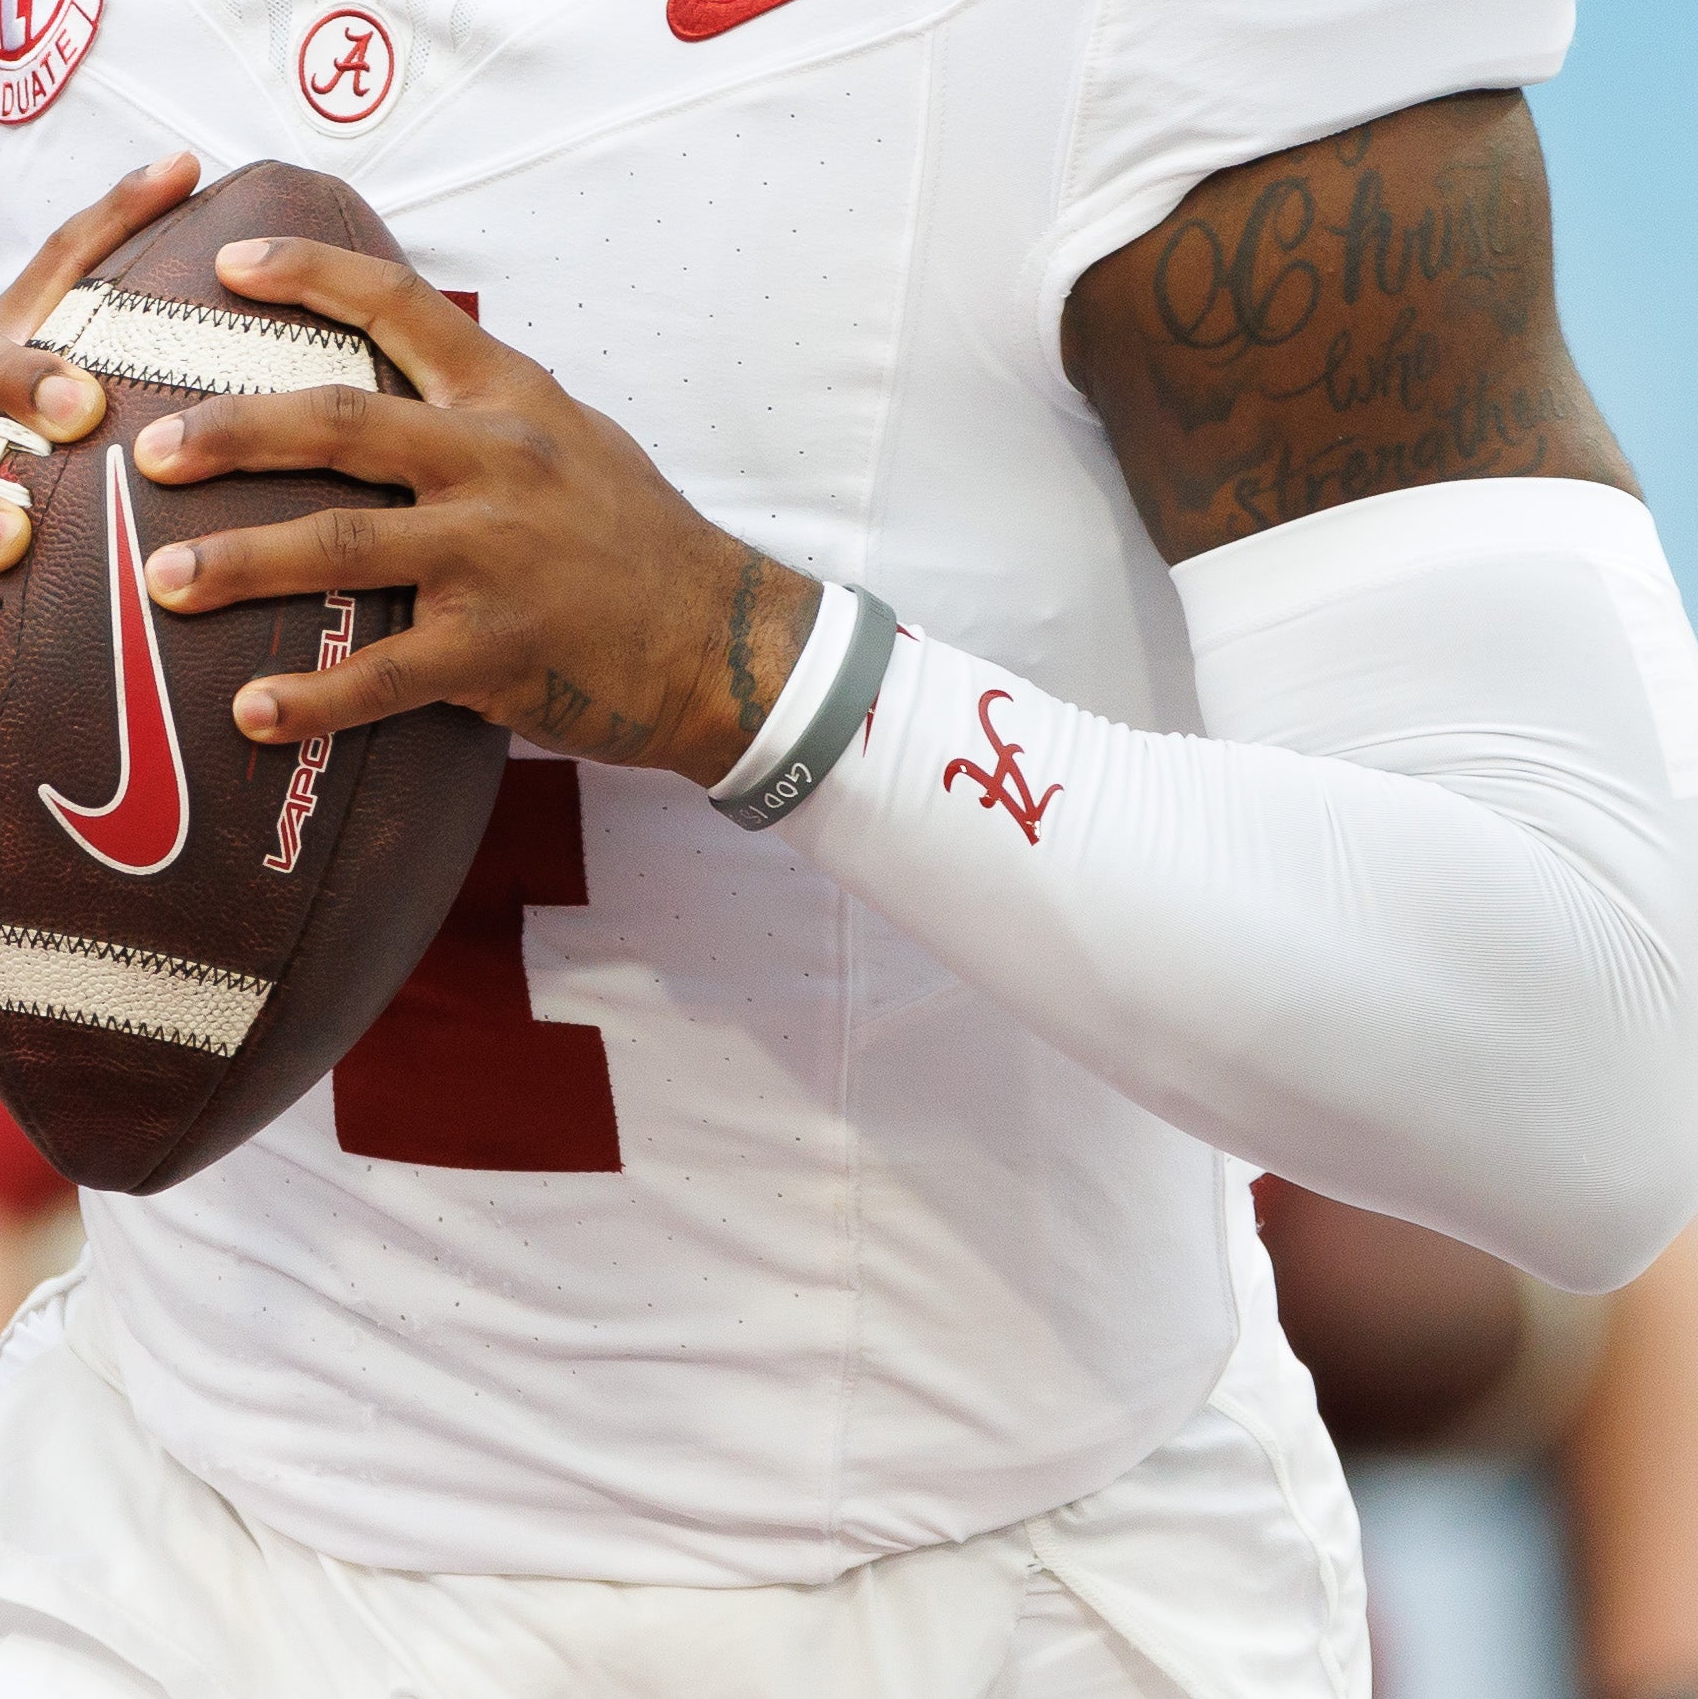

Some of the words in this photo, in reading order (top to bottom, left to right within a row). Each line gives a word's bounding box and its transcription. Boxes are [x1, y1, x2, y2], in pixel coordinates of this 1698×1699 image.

[311, 27, 374, 97] A
[763, 761, 813, 809] GOD
[943, 689, 1065, 848] A
